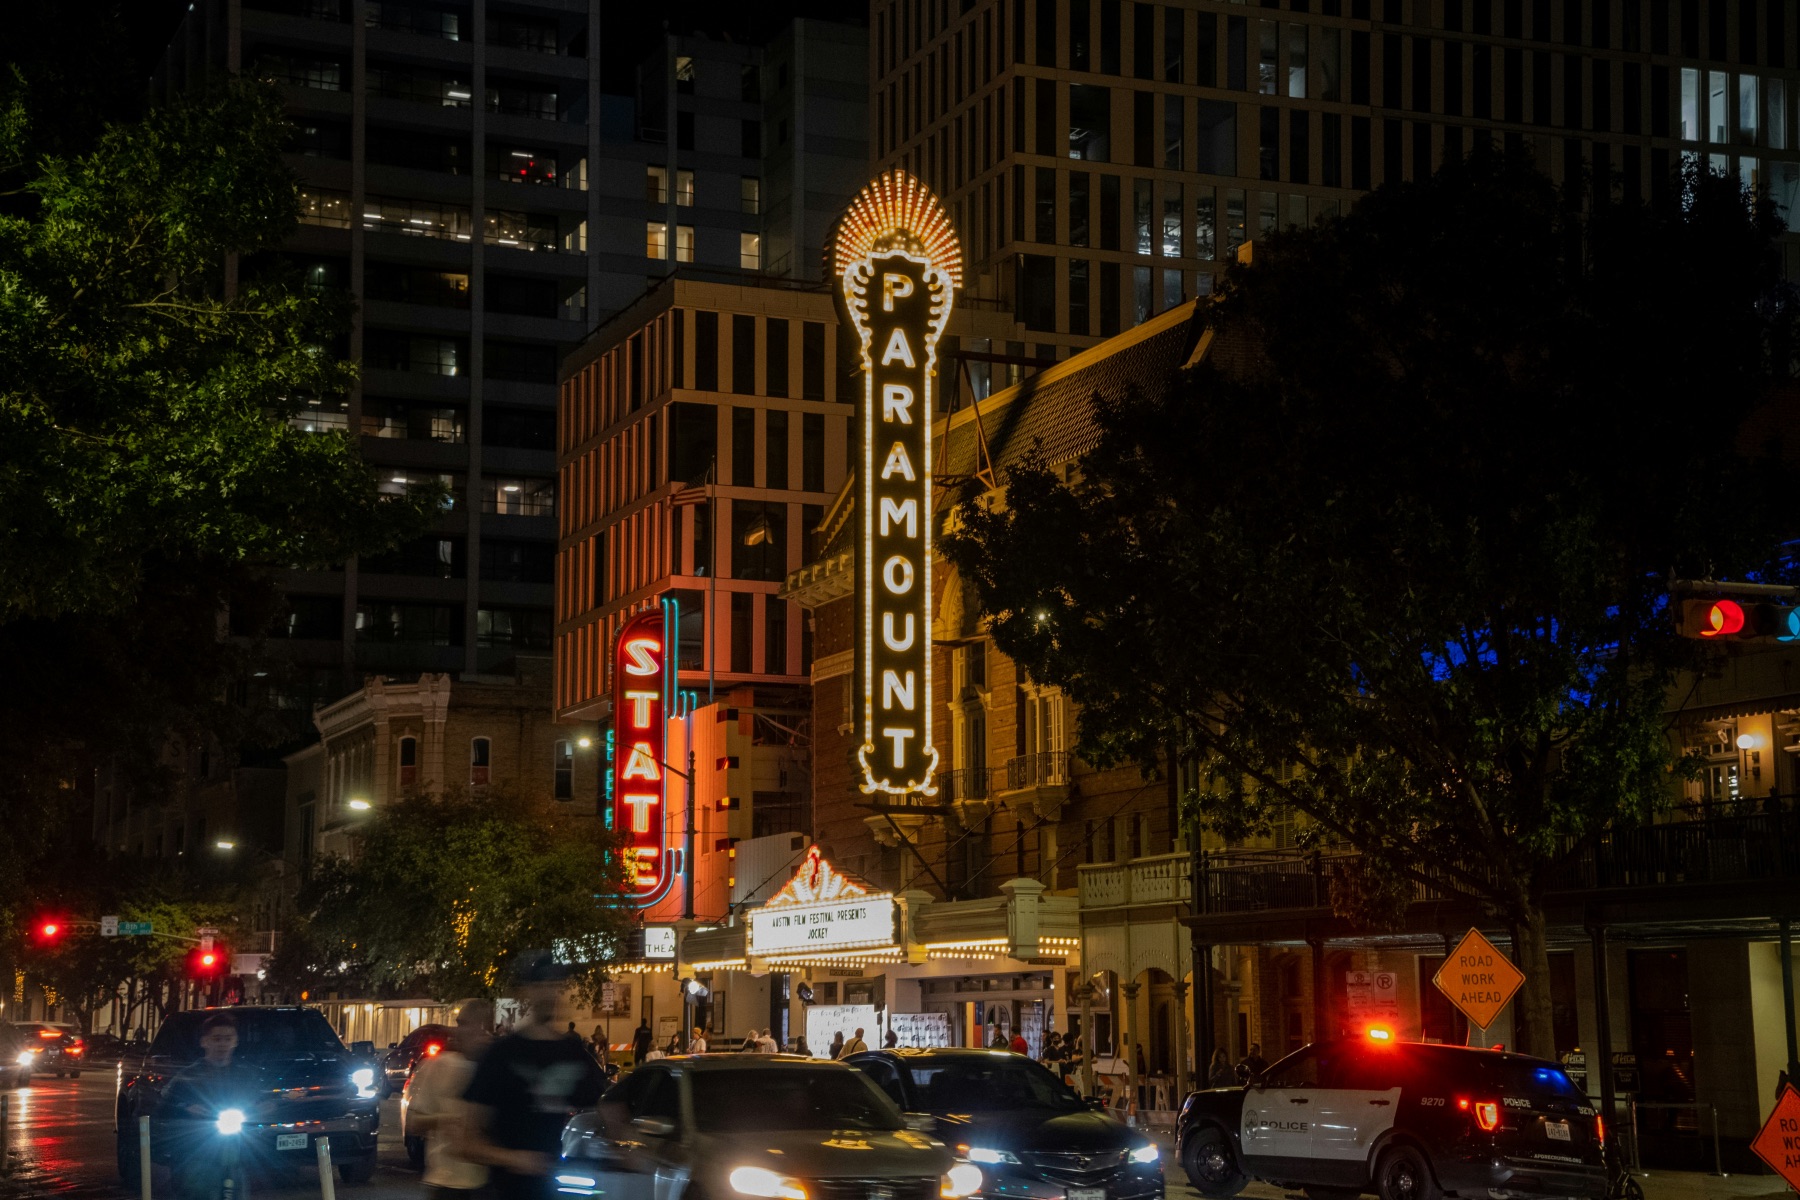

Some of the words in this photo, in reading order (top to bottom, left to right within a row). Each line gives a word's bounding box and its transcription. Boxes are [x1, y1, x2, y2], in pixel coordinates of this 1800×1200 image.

[880, 273, 917, 769] PARAMOUNT
[623, 640, 661, 886] STATE
[772, 916, 791, 928] AUSTIN
[794, 914, 806, 925] FILM
[809, 912, 834, 925] FESTIVAL
[837, 908, 866, 921] PRESENTS
[807, 928, 829, 940] JOCKEY
[1460, 956, 1493, 967] ROAD
[1462, 973, 1495, 985] WORK
[1460, 992, 1502, 1003] AHEAD
[1421, 1097, 1445, 1107] 9270
[1503, 1098, 1532, 1108] POLICE
[1260, 1121, 1309, 1131] POLICE
